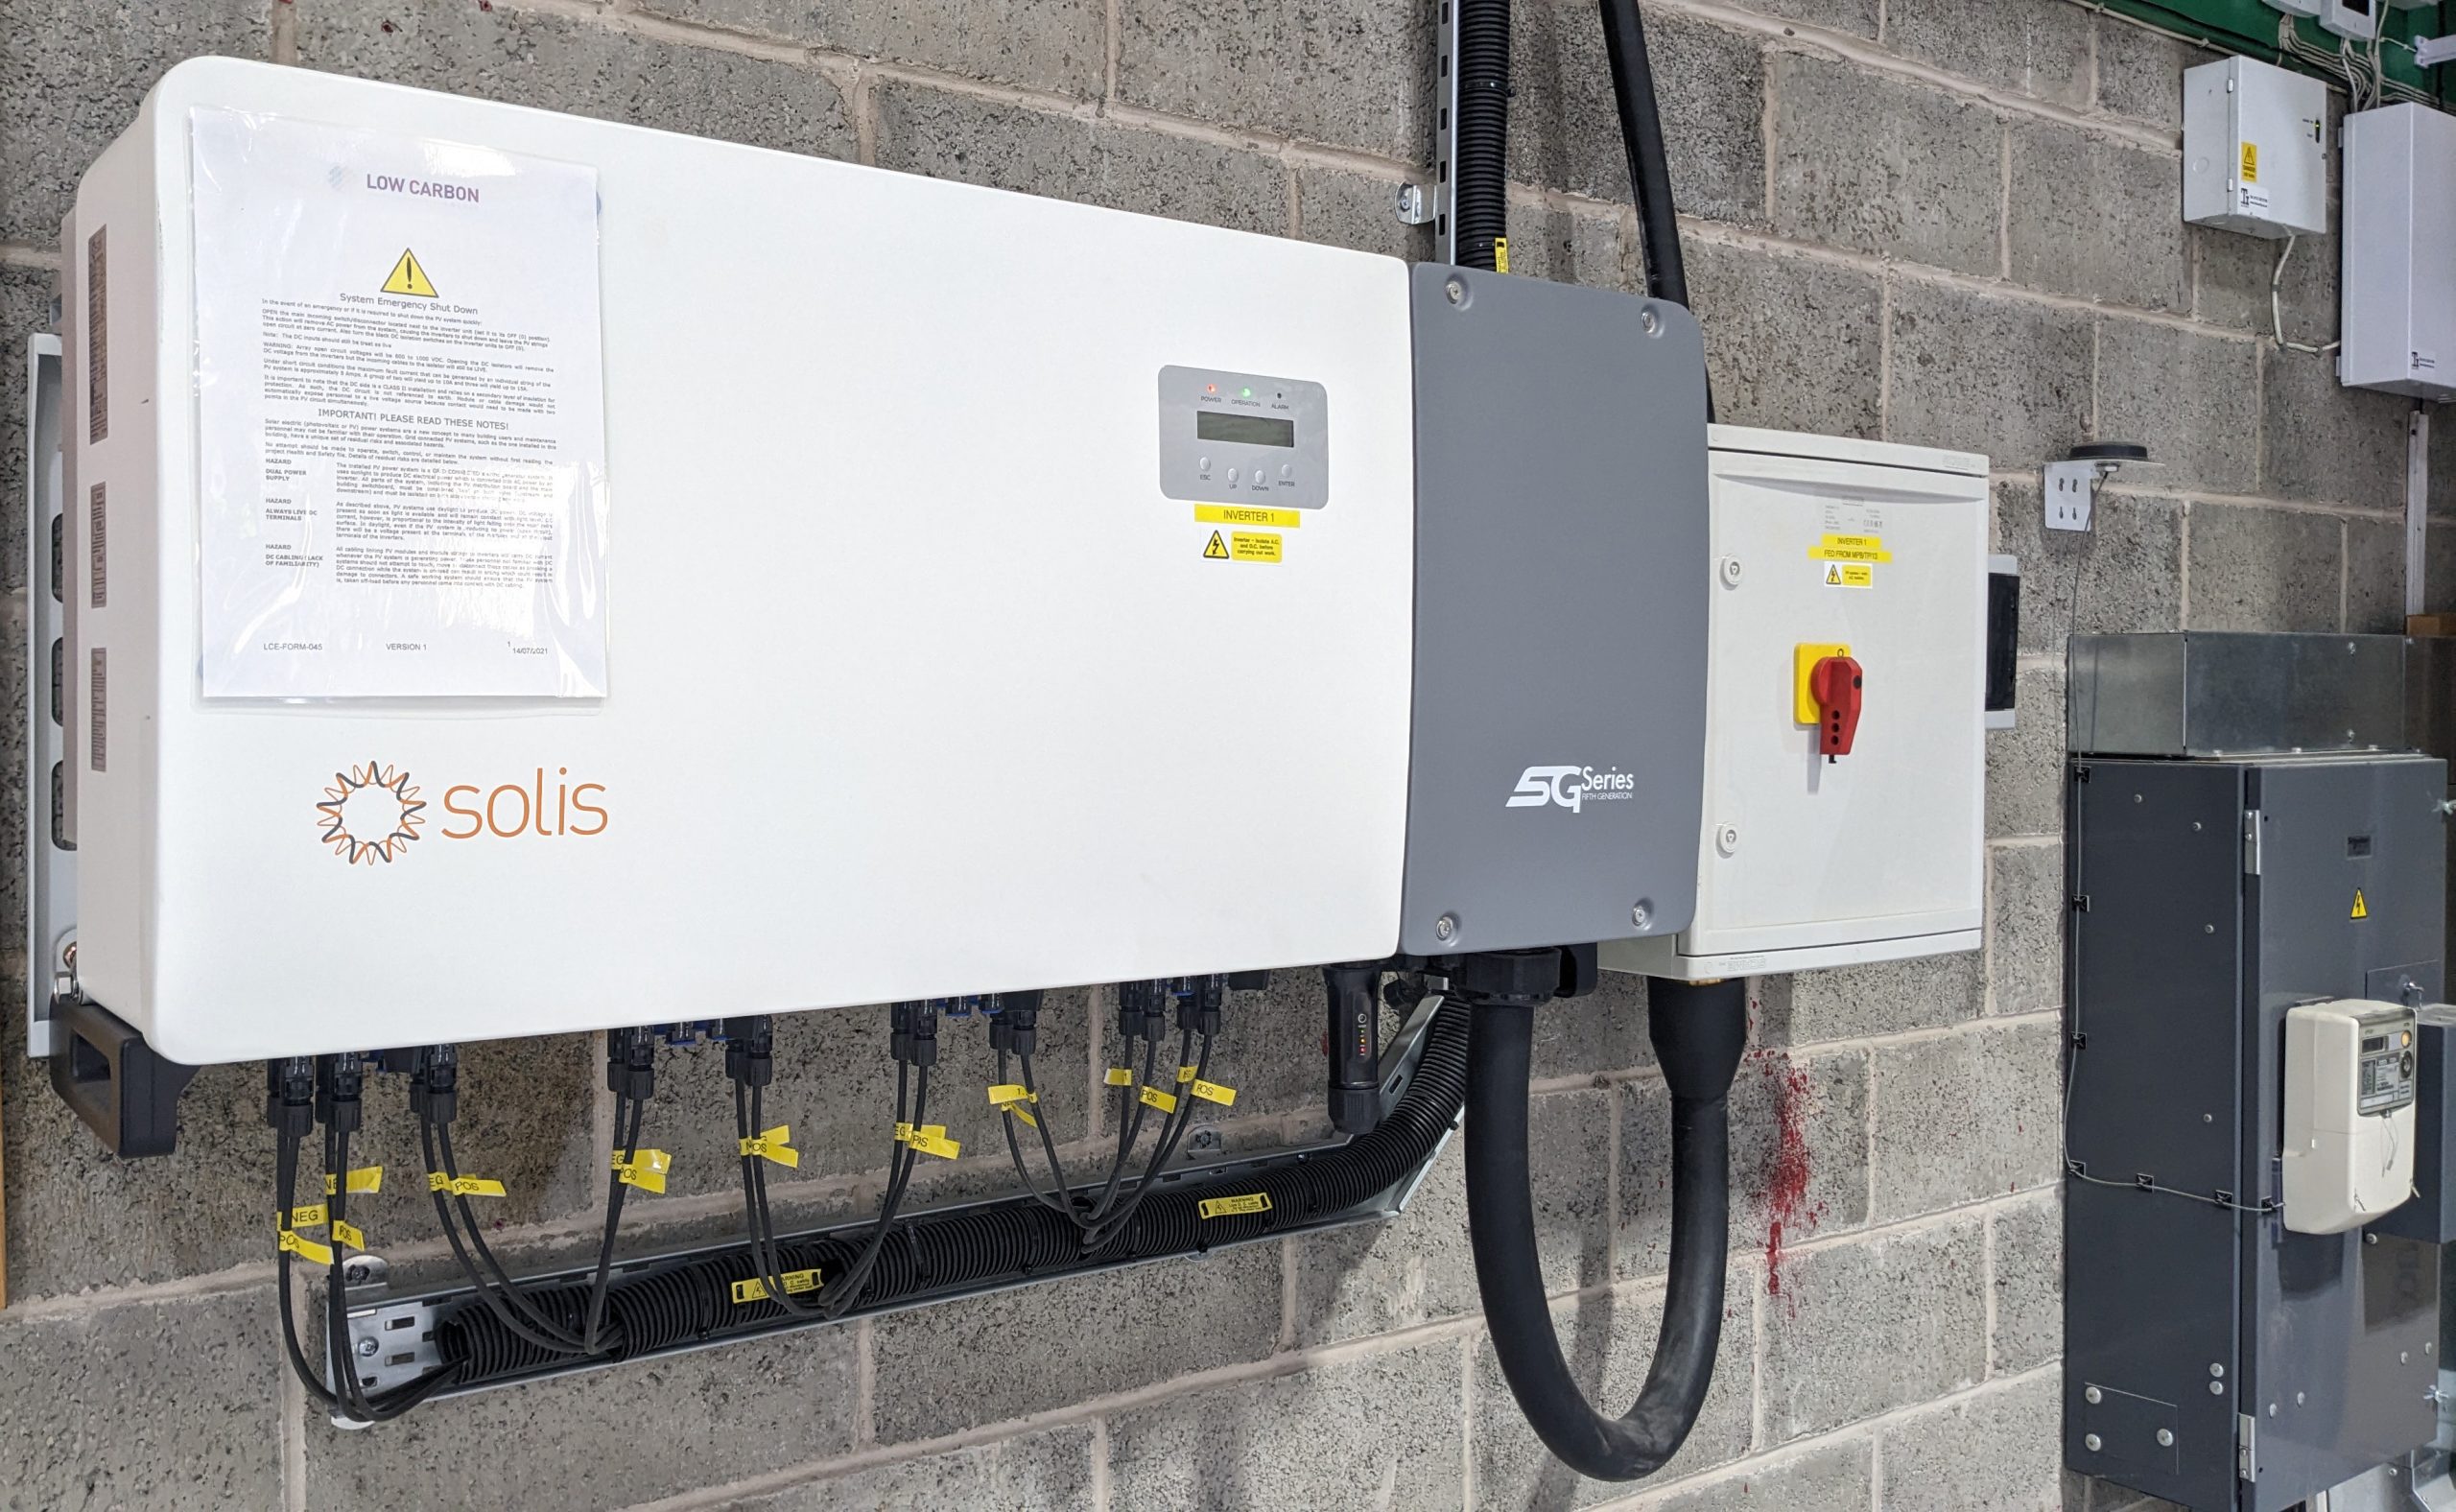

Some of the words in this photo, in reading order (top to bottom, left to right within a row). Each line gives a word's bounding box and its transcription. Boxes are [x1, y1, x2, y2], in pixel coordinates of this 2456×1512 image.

[366, 173, 405, 192] LOW
[409, 180, 479, 203] CARBON
[340, 293, 374, 304] System
[377, 297, 427, 311] Emergency
[430, 303, 450, 312] Shut
[453, 305, 478, 315] Down
[1231, 399, 1261, 408] OPERATION
[318, 409, 377, 421] IMPORTANT!
[380, 413, 414, 423] PLEASE
[417, 416, 441, 425] READ
[444, 418, 473, 427] THESE
[476, 420, 509, 430] NOTES!
[1223, 509, 1269, 522] INVERTER
[1270, 513, 1275, 522] 1
[1837, 537, 1863, 545] INVERTER
[1582, 766, 1635, 791] Series
[1597, 792, 1633, 800] GENERATION
[441, 767, 609, 839] solis
[1141, 1090, 1158, 1103] POS
[895, 1126, 905, 1136] EG
[753, 1143, 767, 1153] OS
[612, 1154, 624, 1165] EG
[429, 1175, 443, 1187] EG
[455, 1181, 479, 1191] POS
[292, 1210, 318, 1222] NEG
[339, 1225, 351, 1241] POS
